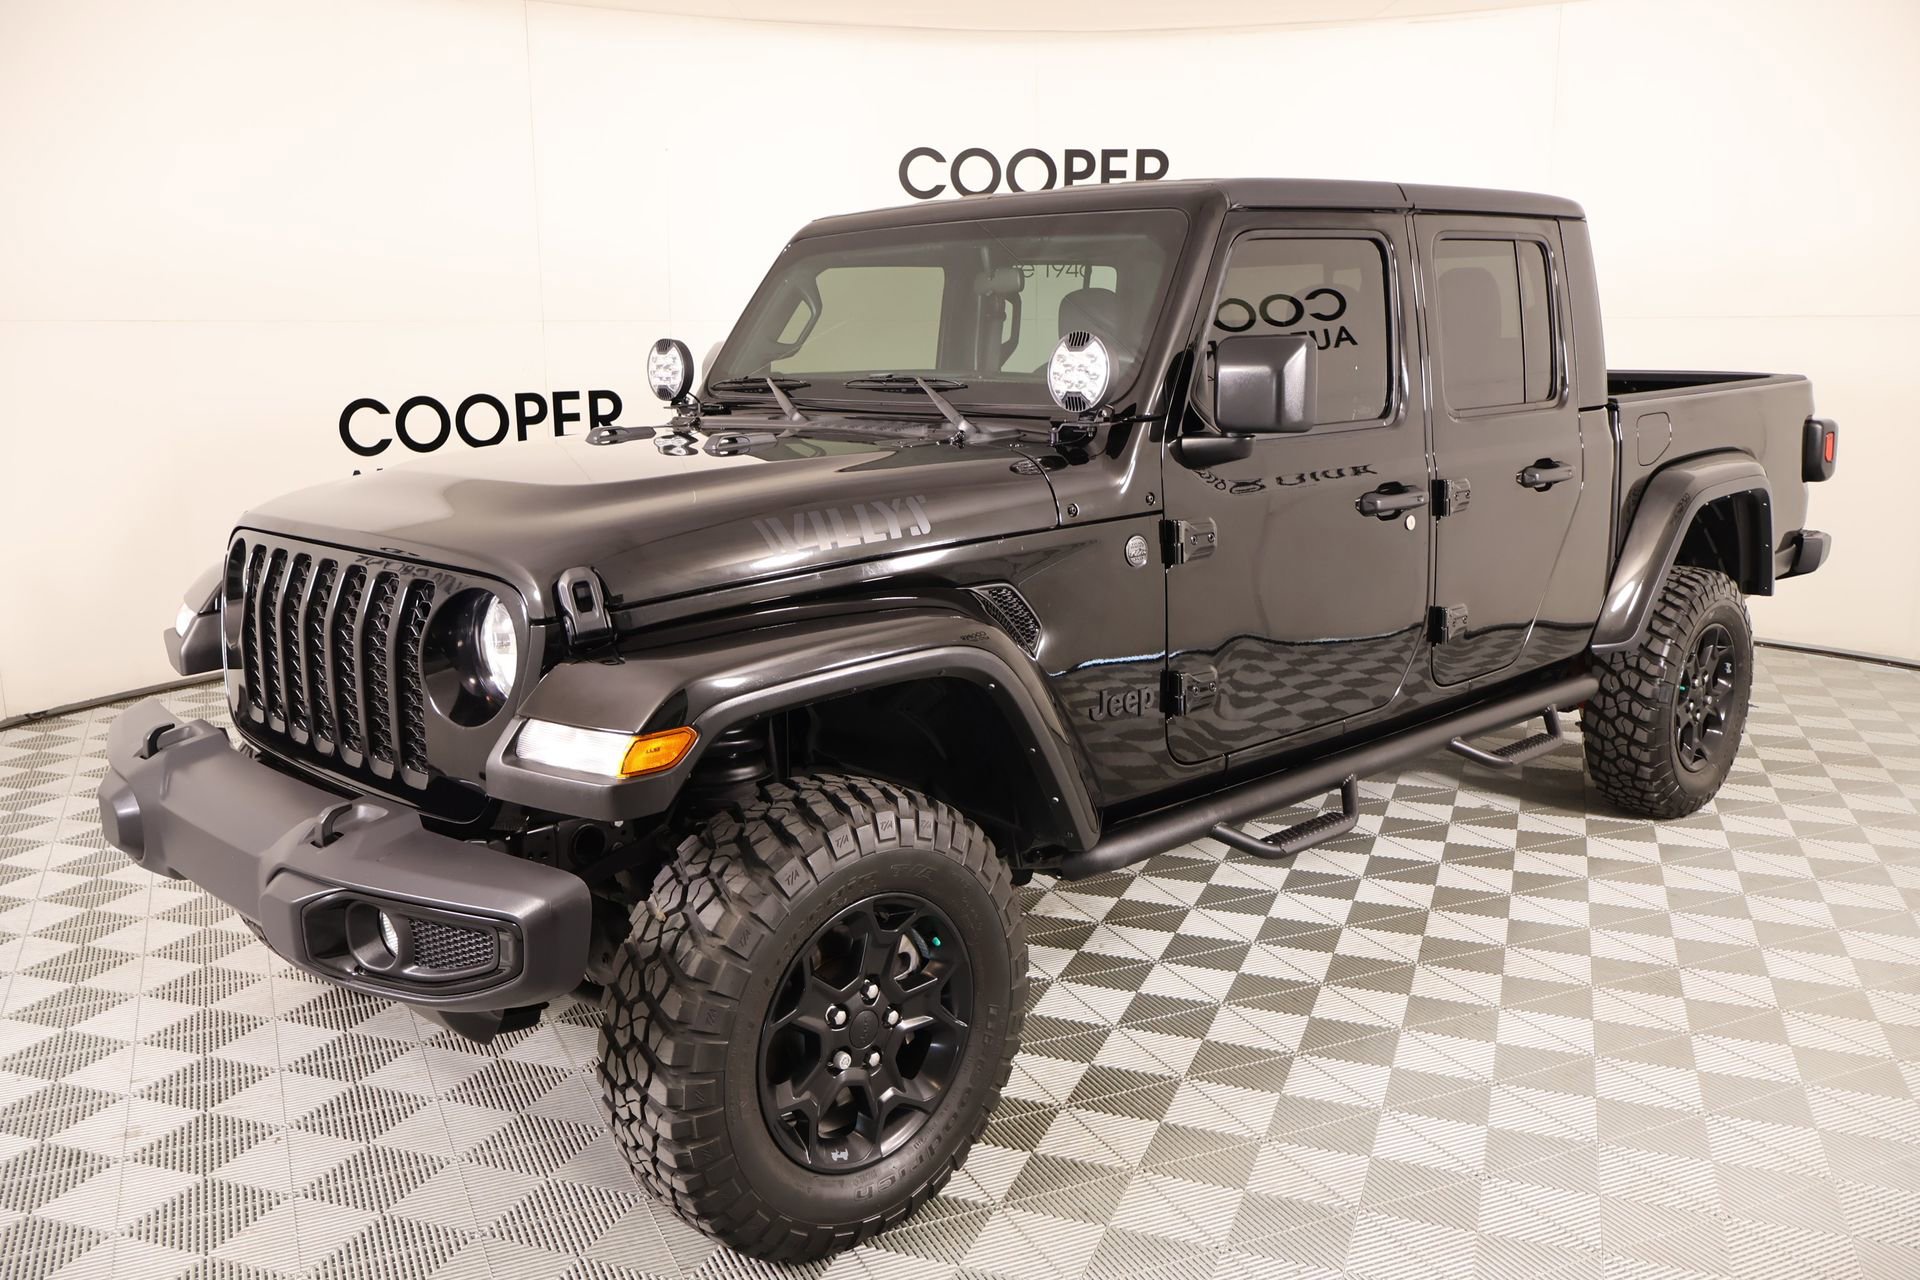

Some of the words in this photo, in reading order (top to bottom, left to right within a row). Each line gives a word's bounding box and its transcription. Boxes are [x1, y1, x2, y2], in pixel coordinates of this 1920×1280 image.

[899, 147, 1170, 199] COOPER
[339, 390, 623, 456] COOPER
[752, 494, 932, 554] WILLYS
[1088, 686, 1155, 721] Jeep
[835, 834, 849, 848] T/A
[880, 820, 893, 831] T/A
[784, 869, 800, 886] T/A
